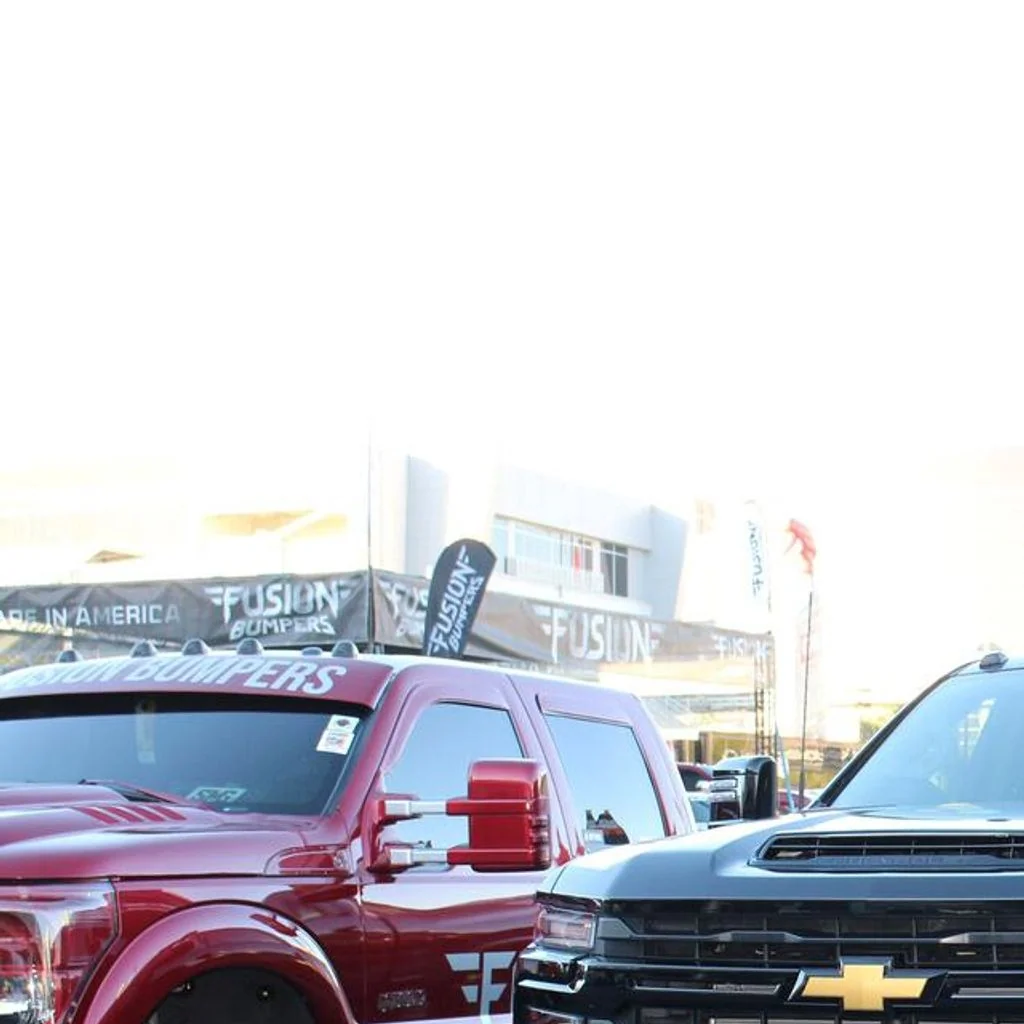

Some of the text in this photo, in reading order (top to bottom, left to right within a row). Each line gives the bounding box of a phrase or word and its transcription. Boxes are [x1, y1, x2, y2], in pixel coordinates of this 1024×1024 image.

[45, 607, 67, 627] IN
[76, 603, 181, 626] AMERICA
[206, 578, 352, 624] FUSION
[428, 545, 478, 656] FUSION
[230, 615, 335, 639] BUMPERS
[532, 604, 667, 664] FUSION
[125, 657, 347, 695] BUMPERS
